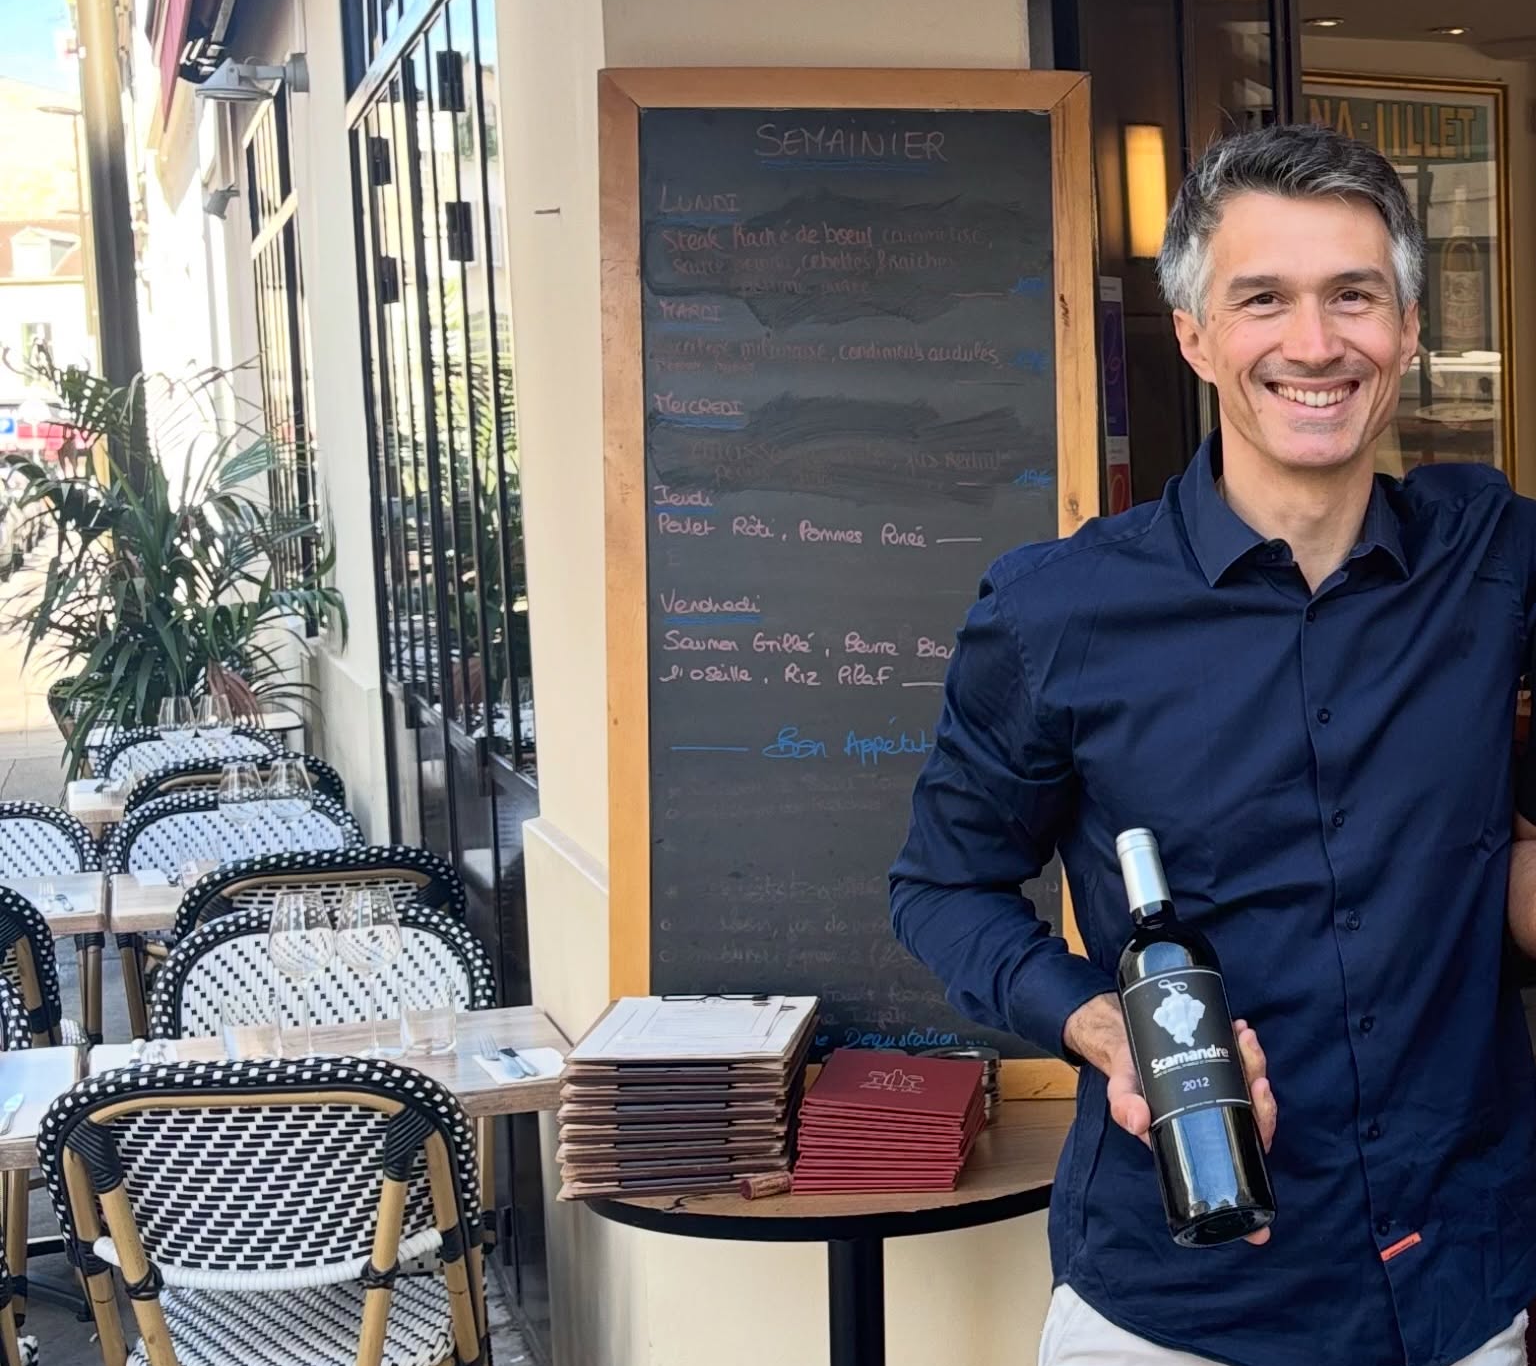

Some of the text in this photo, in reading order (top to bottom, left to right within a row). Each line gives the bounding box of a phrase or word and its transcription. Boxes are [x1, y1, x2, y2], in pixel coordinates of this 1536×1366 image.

[755, 121, 948, 163] SEMAINIER
[660, 184, 742, 213] LUNDI
[658, 513, 718, 536] Poulet
[799, 519, 863, 545] Pommes
[660, 594, 761, 615] Vendredi
[663, 629, 740, 652] Saumon
[845, 631, 899, 657] Beurre
[784, 663, 822, 686] Riz
[837, 665, 894, 687] Pilaf
[761, 726, 828, 758] Bon
[1151, 1044, 1230, 1075] Scamandre
[1182, 1076, 1210, 1092] 2012
